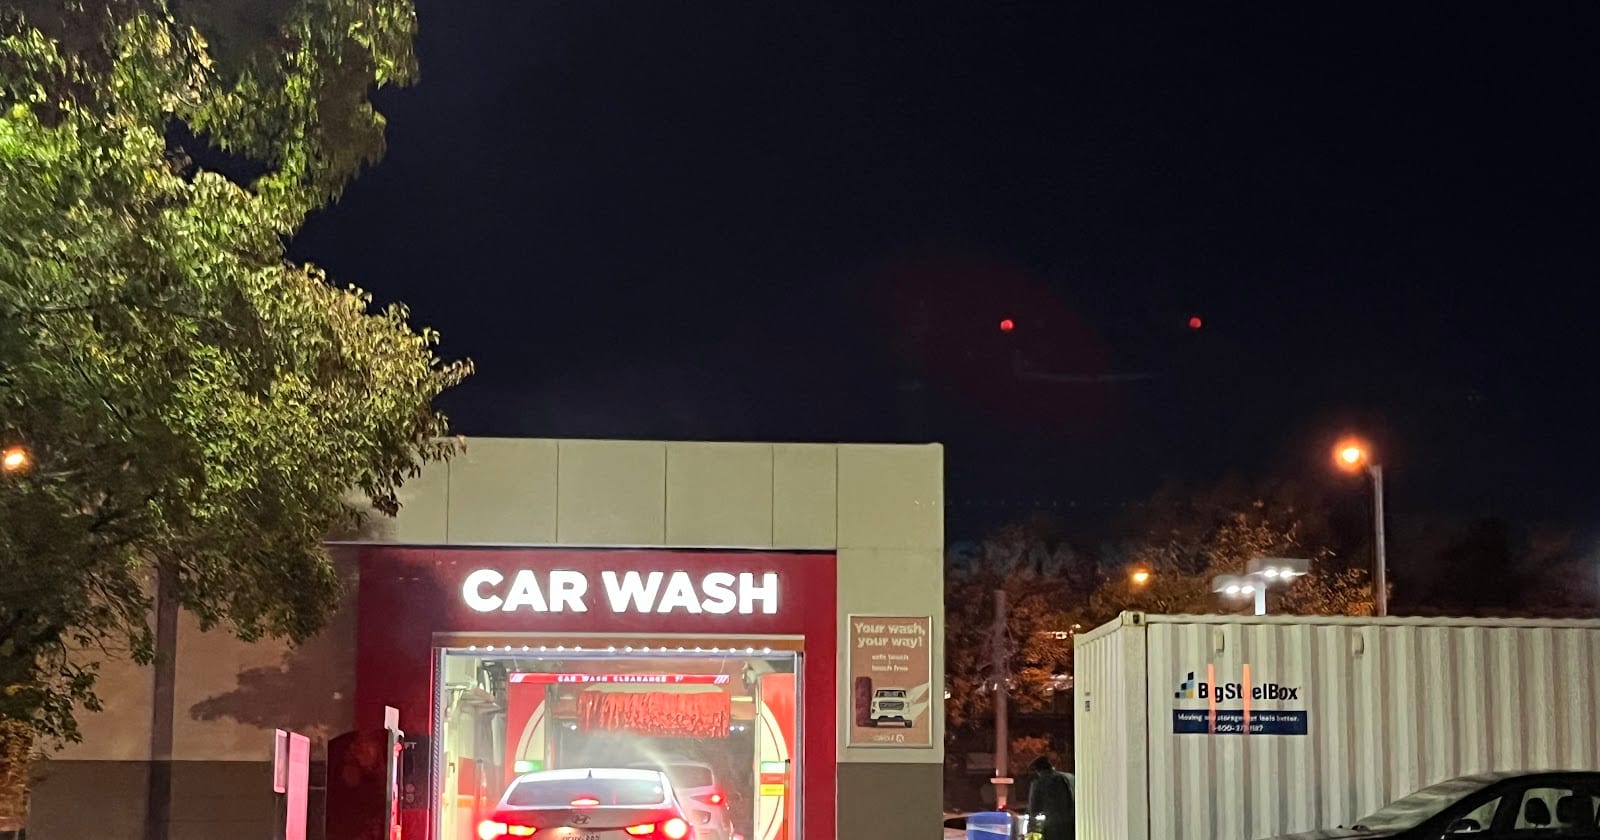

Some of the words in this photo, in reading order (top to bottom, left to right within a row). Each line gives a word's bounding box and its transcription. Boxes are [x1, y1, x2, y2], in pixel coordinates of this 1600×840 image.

[462, 568, 588, 612] CAR
[602, 570, 778, 614] WASH
[855, 622, 886, 634] Your
[888, 622, 925, 635] wash,
[857, 636, 889, 648] your
[891, 636, 922, 648] way!
[557, 674, 576, 683] CAR
[582, 674, 608, 683] WASH
[613, 674, 666, 683] CLEARANCE
[1198, 682, 1299, 703] BgStelBox
